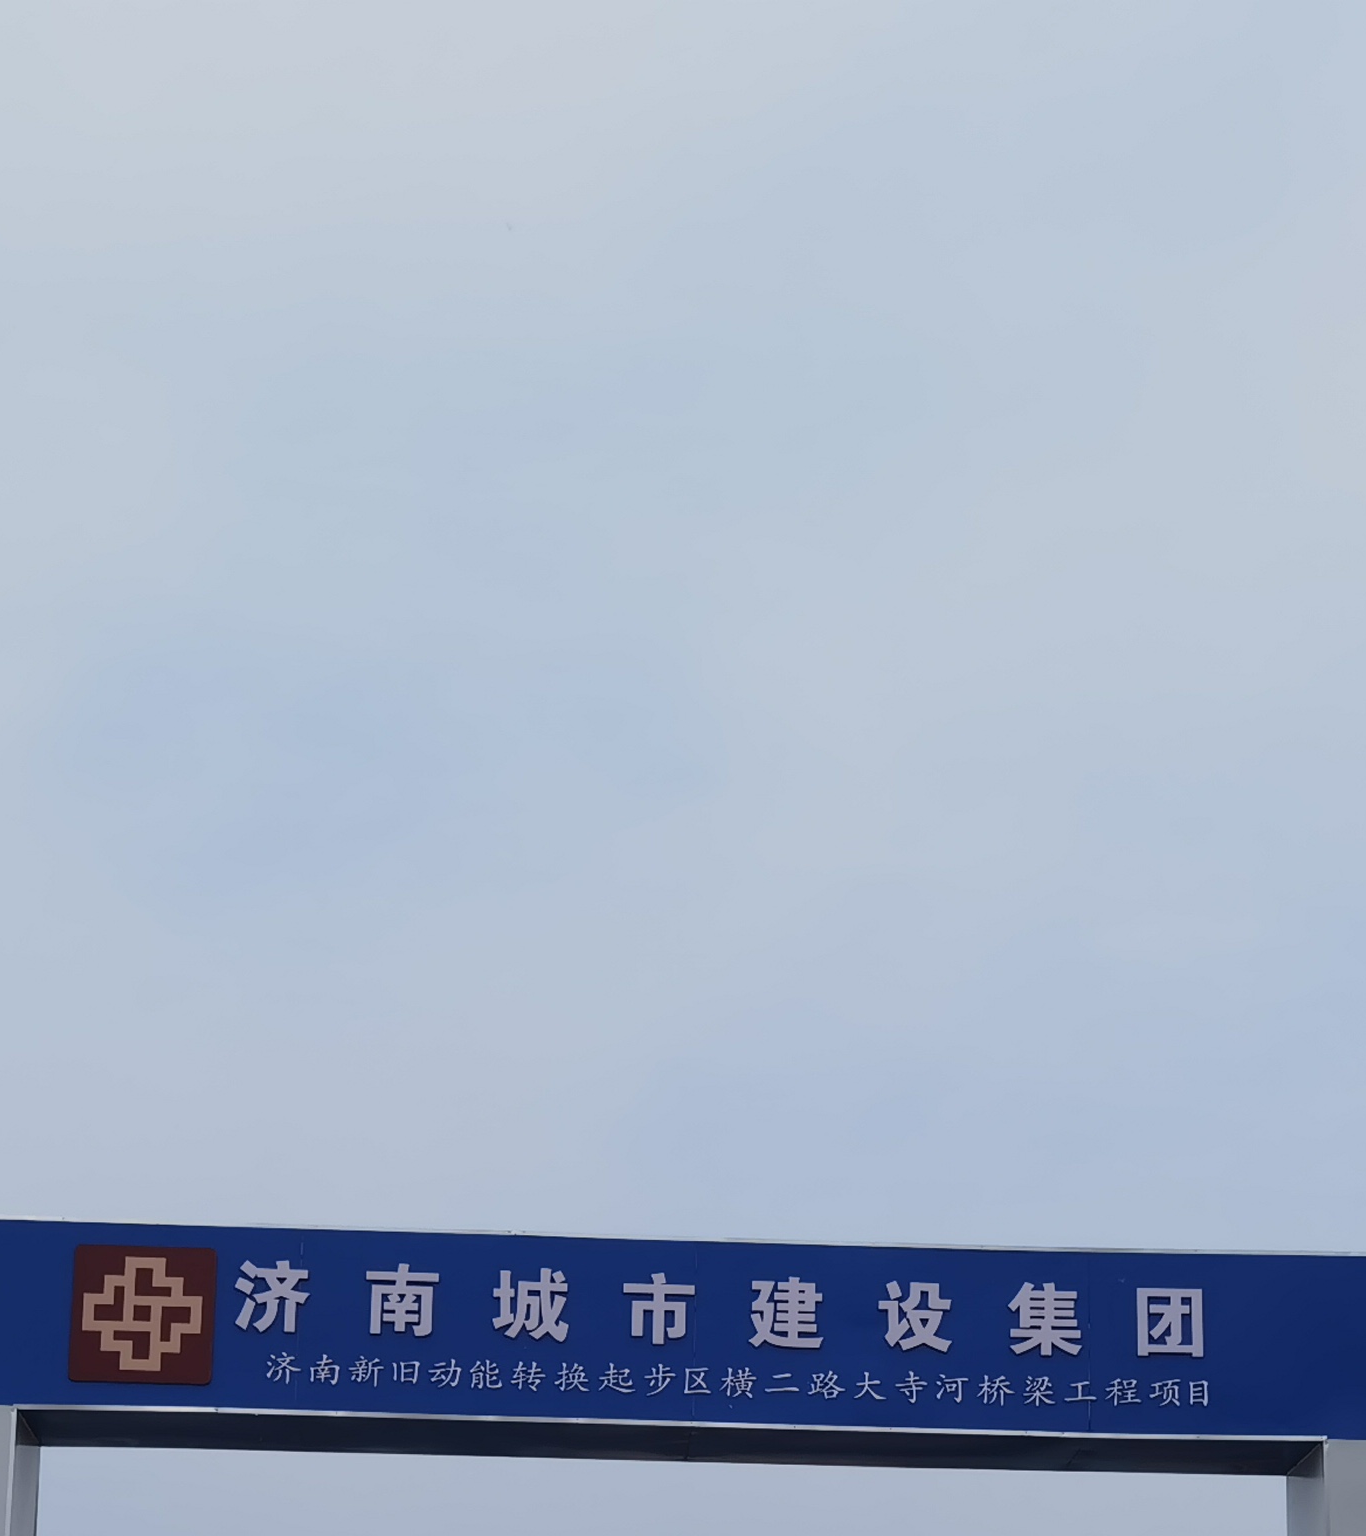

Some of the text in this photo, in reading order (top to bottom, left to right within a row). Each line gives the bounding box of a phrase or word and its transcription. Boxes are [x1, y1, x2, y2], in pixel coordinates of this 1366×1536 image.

[234, 1258, 1205, 1358] 济南城市建设集团
[265, 1352, 1211, 1408] 济南新旧动能转换起步区横二路大寺河桥梁工程项目
